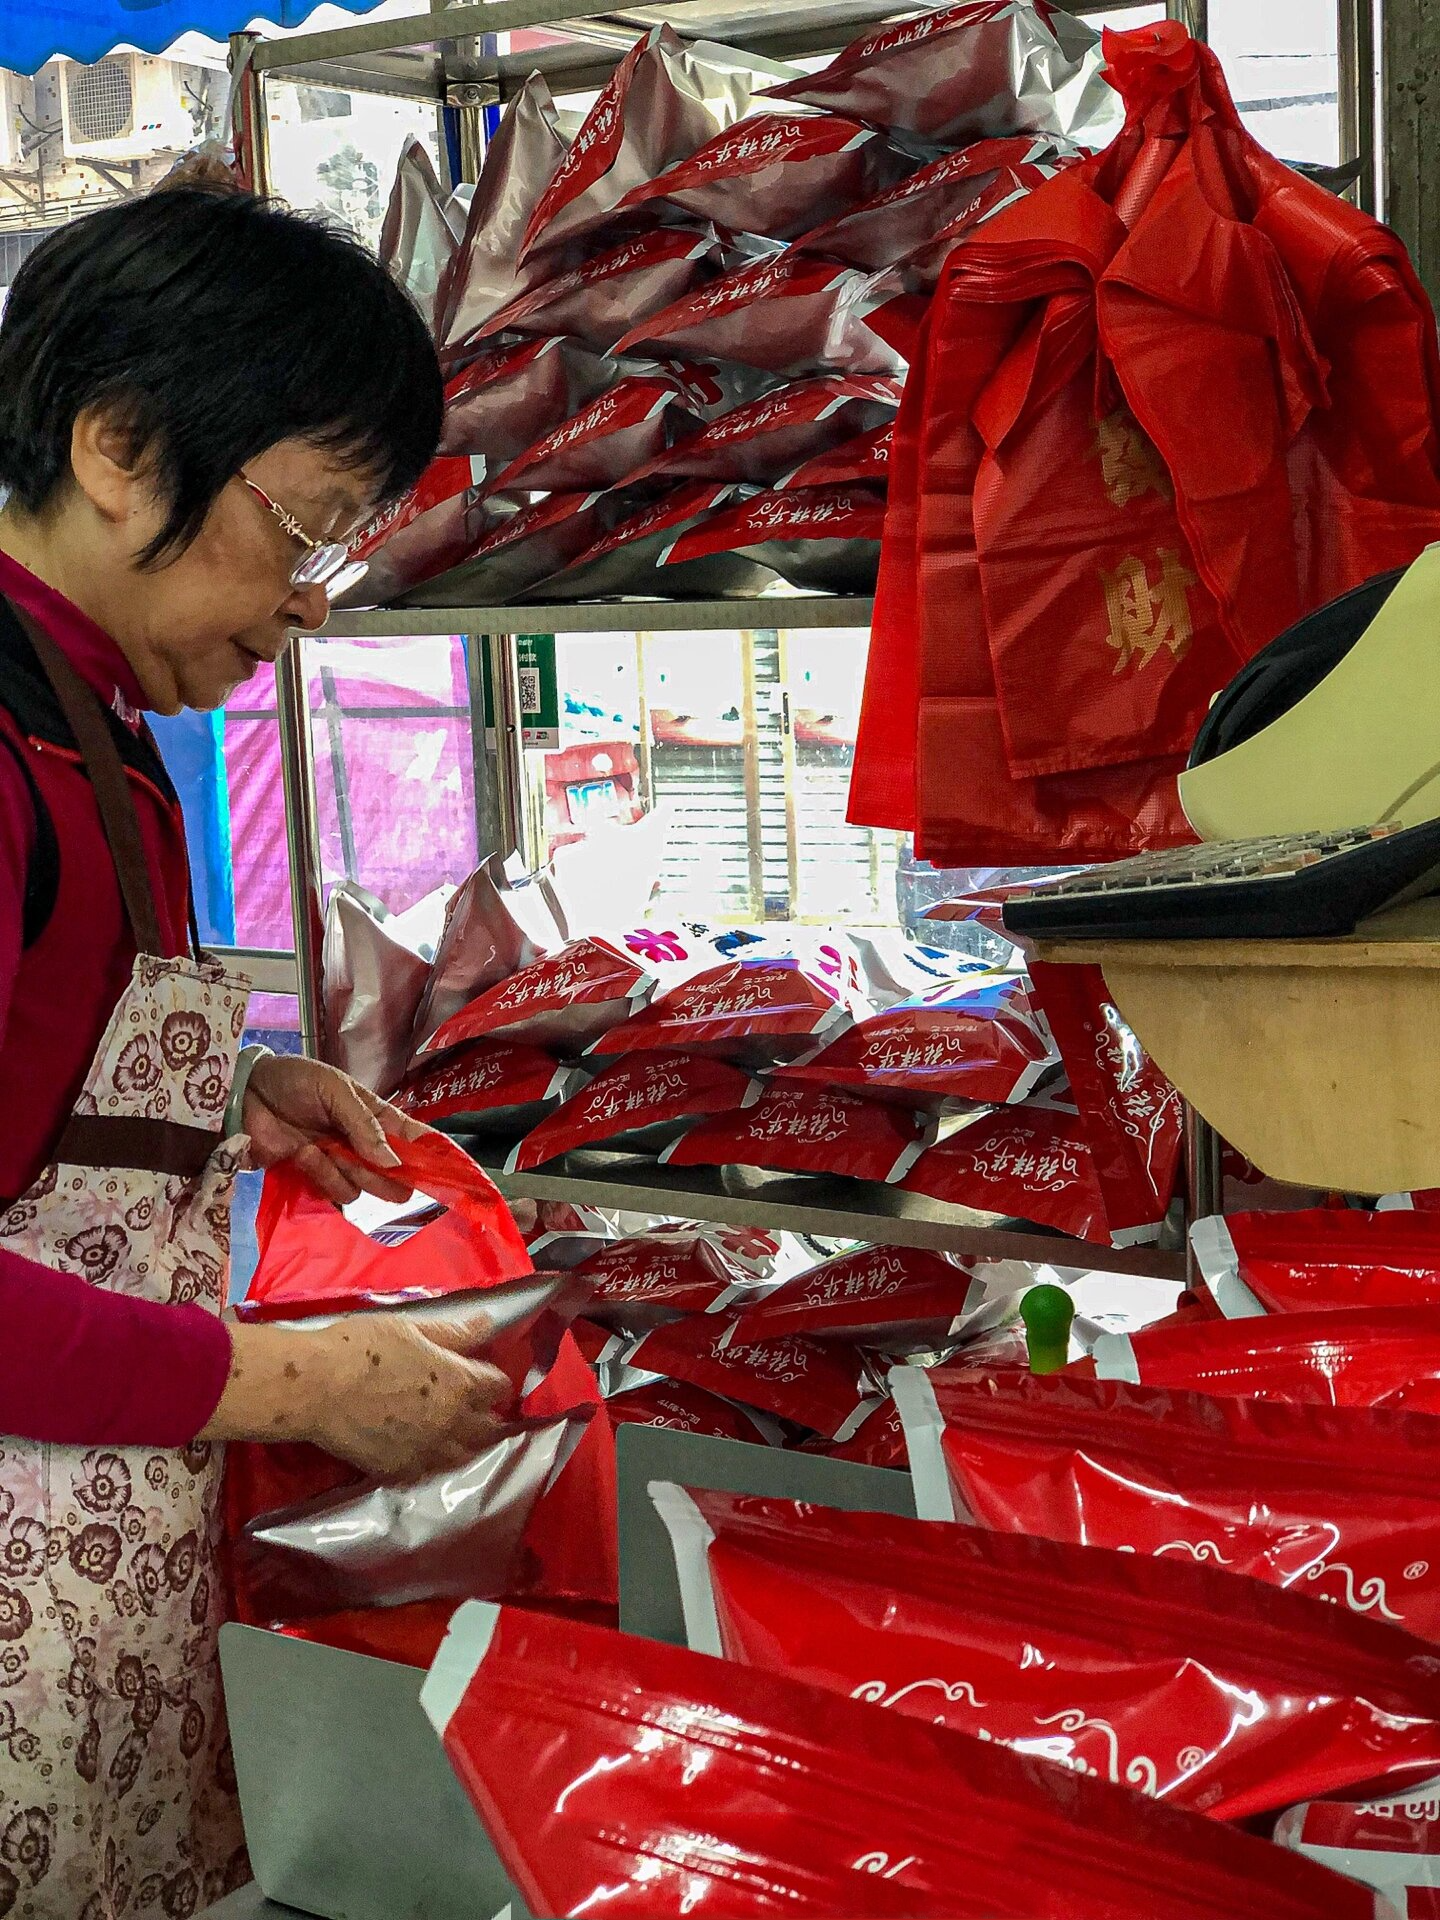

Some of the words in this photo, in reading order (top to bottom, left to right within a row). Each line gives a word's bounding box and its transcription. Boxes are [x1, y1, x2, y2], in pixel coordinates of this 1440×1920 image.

[515, 970, 572, 1004] 张祥华
[690, 993, 755, 1017] 张祥华
[878, 1043, 944, 1068] 张祥华
[431, 1068, 486, 1102] 张祥华
[603, 1081, 667, 1117] 张祥华
[765, 1112, 829, 1135] 张祥华
[991, 1145, 1059, 1181] 张祥华
[602, 1271, 660, 1292] 张祥华
[823, 1266, 887, 1298] 张祥华
